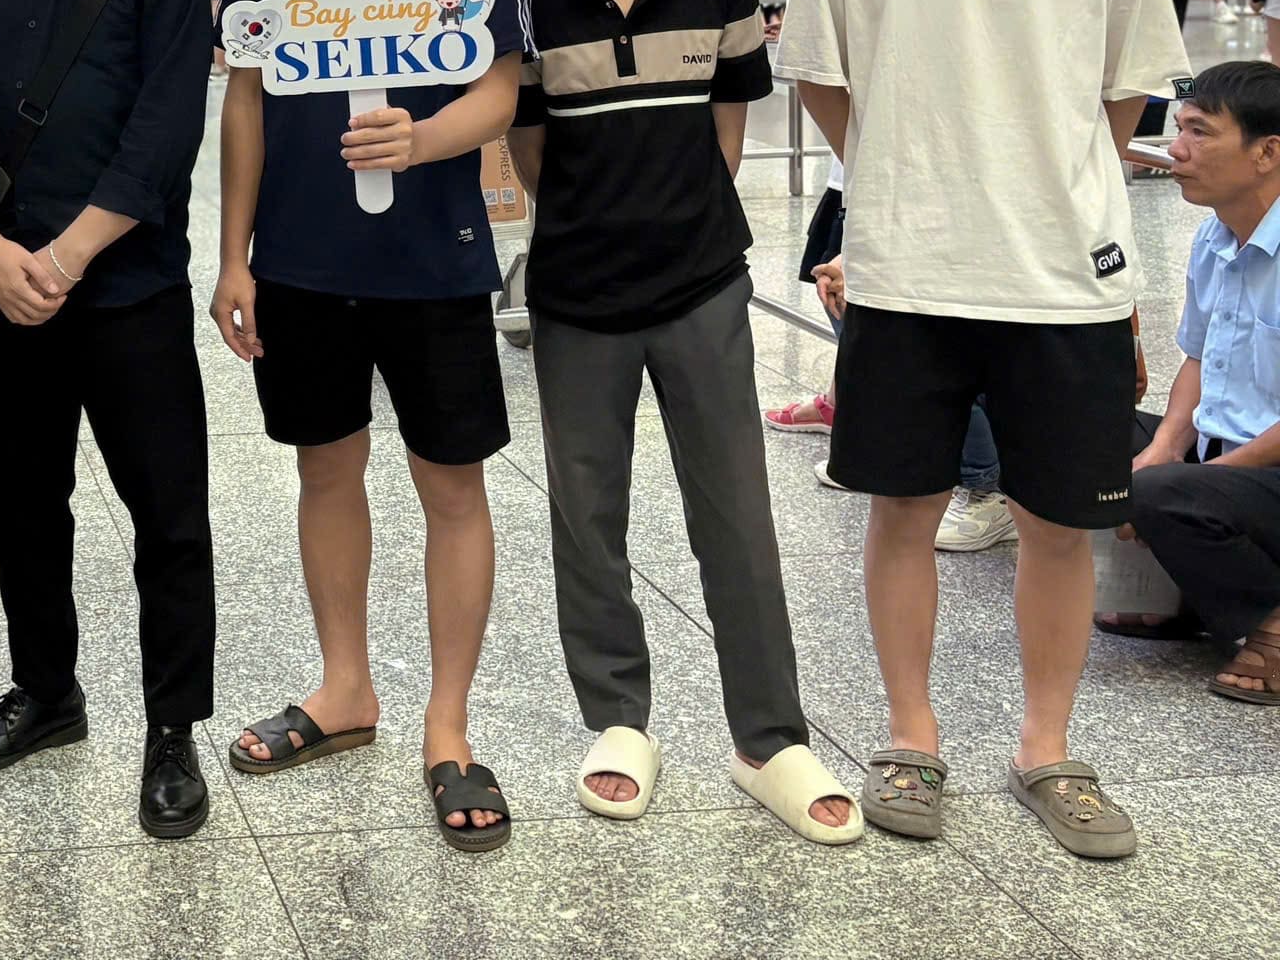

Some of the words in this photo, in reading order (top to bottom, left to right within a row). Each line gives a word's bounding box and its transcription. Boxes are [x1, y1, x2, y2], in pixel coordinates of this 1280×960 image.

[274, 31, 478, 83] SEIKO
[682, 54, 712, 65] DAVID
[498, 137, 511, 181] EXPRESS
[1097, 250, 1121, 270] GVR
